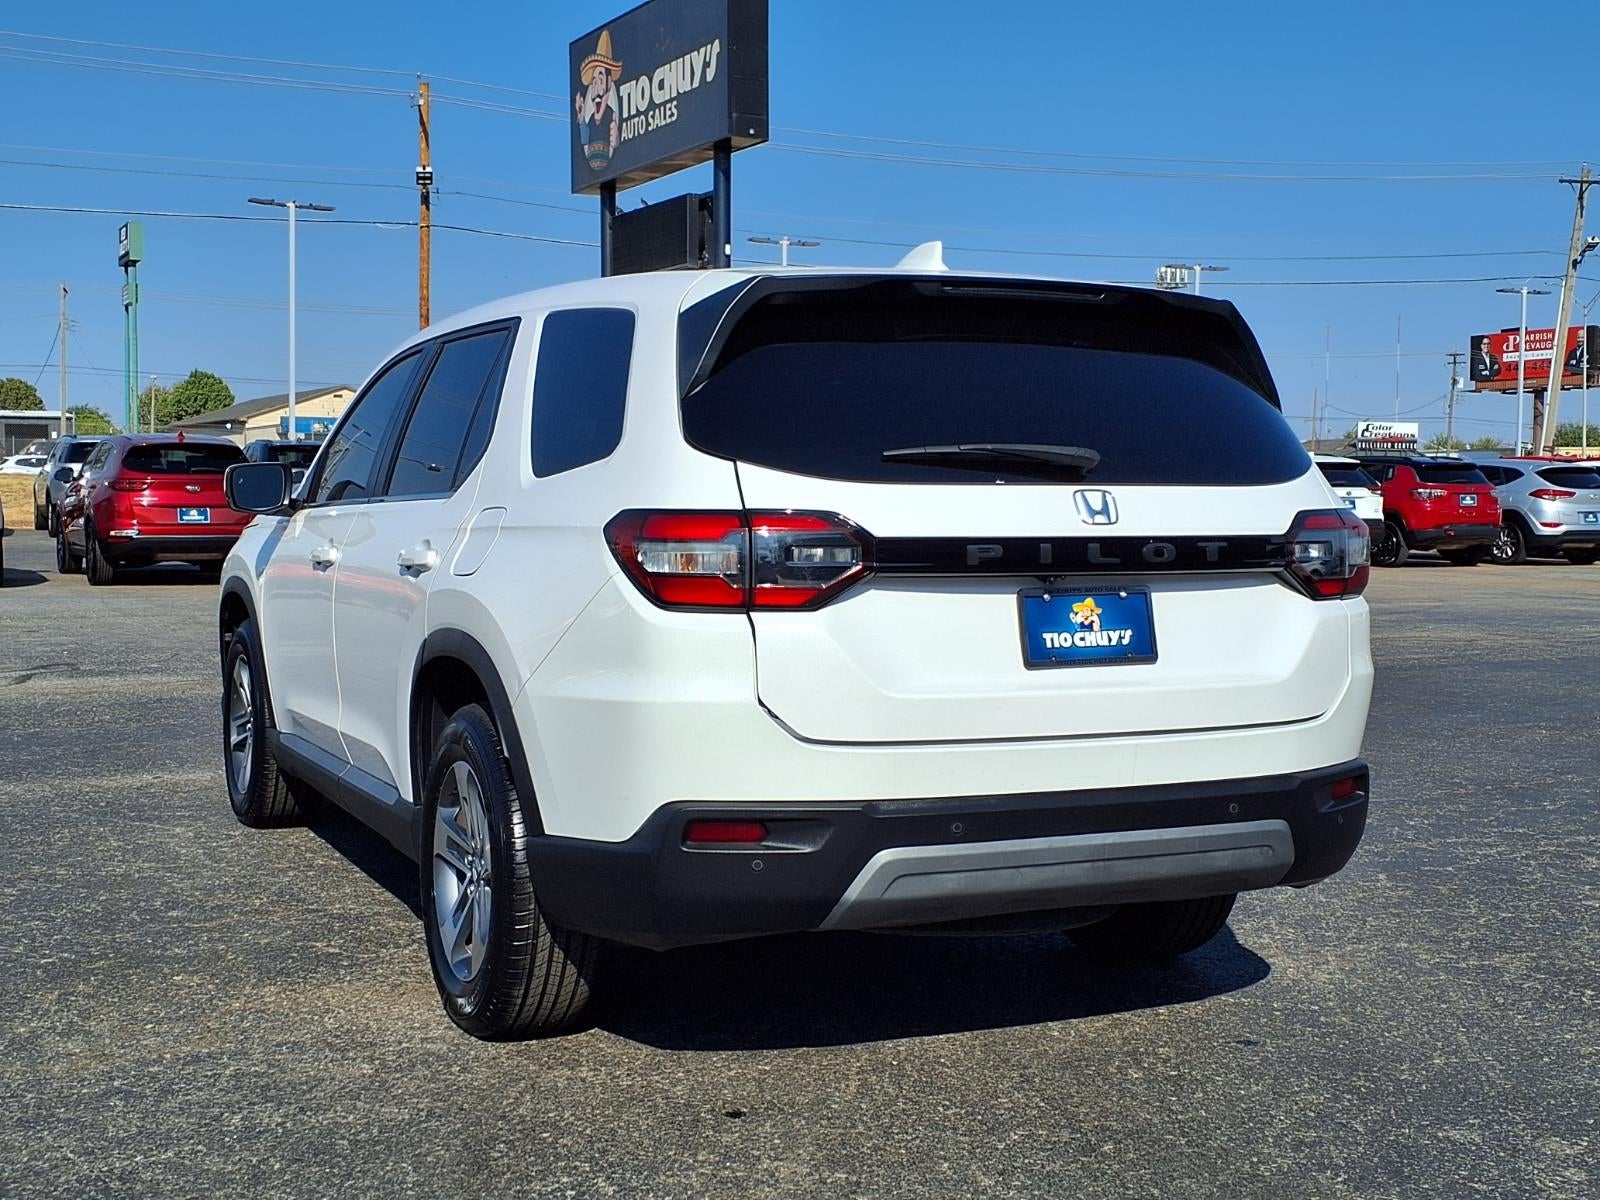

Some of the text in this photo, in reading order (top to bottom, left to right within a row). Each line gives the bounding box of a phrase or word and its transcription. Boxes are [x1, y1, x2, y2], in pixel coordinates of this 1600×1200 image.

[619, 38, 720, 119] TIO CHUY'S
[621, 100, 678, 142] AUTO SALES
[1525, 332, 1553, 341] ARRISH
[1361, 429, 1416, 439] Creations
[1366, 423, 1393, 432] Color
[966, 541, 1228, 566] PILOT
[1042, 629, 1133, 649] TIO CHUY'S
